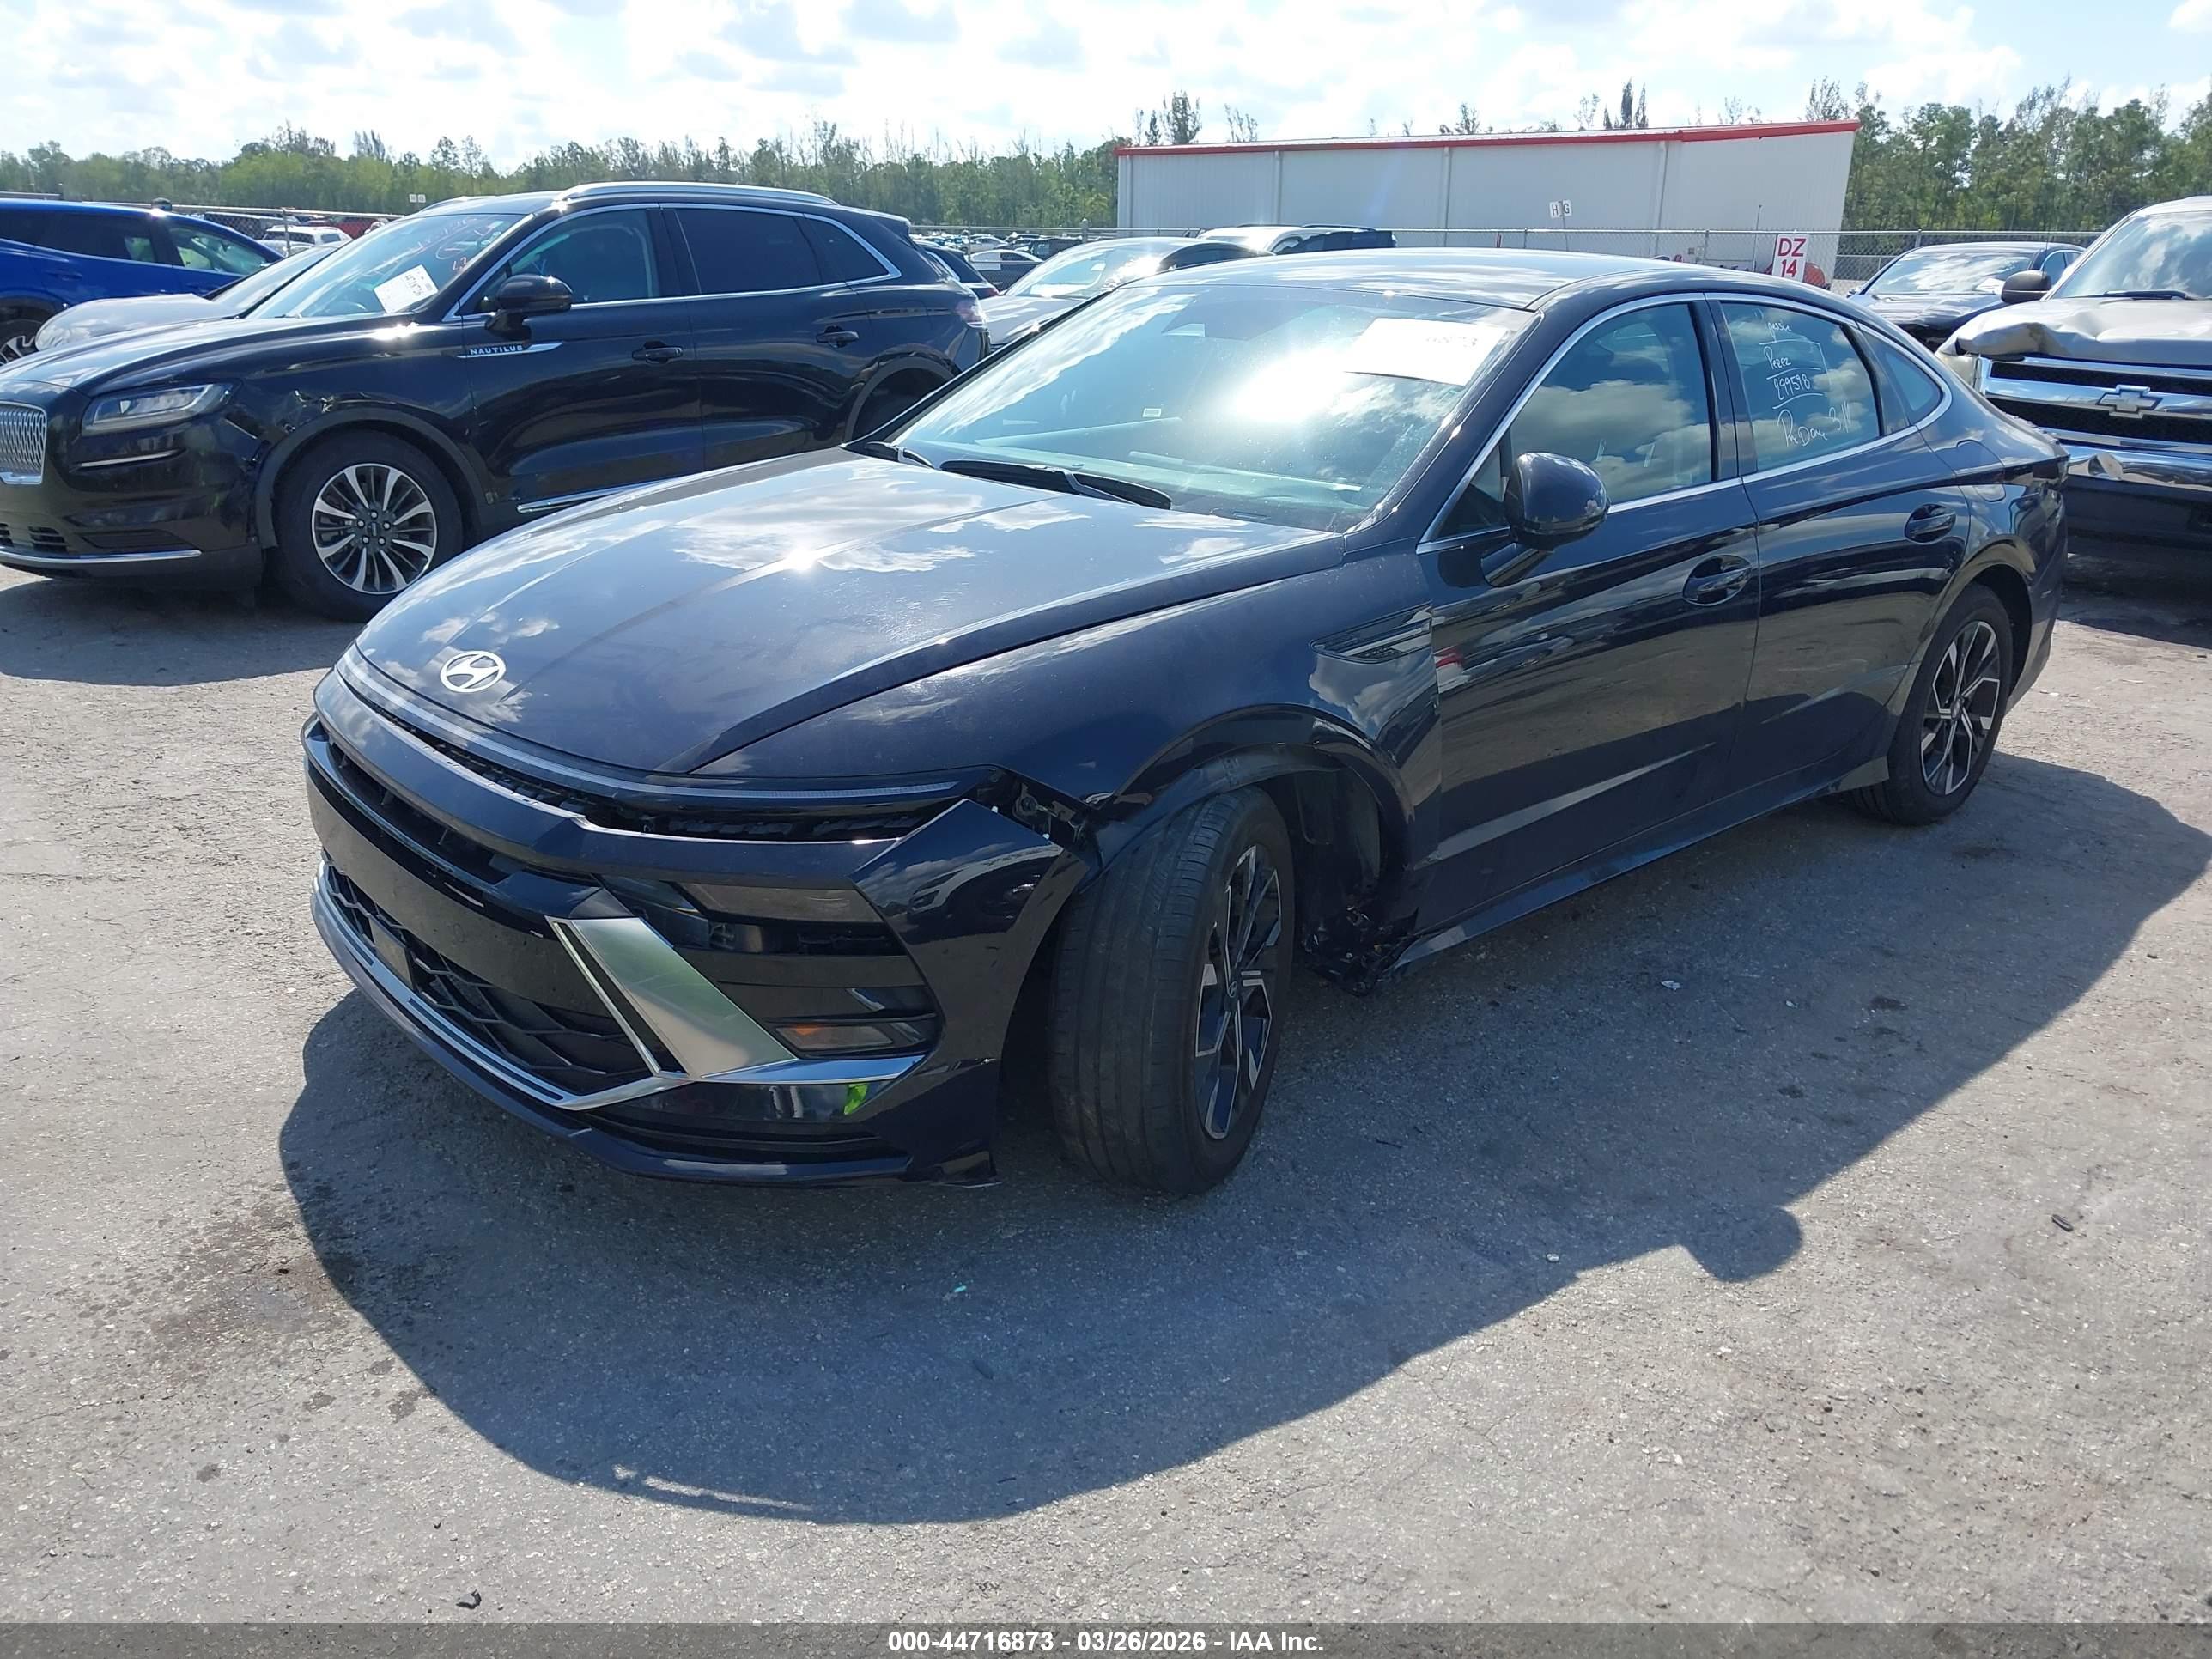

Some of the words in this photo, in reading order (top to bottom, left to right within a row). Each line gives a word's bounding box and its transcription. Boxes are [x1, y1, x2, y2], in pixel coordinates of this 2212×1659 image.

[1778, 238, 1807, 257] DZ
[1781, 259, 1797, 278] 14
[470, 345, 523, 355] NAUTILUS
